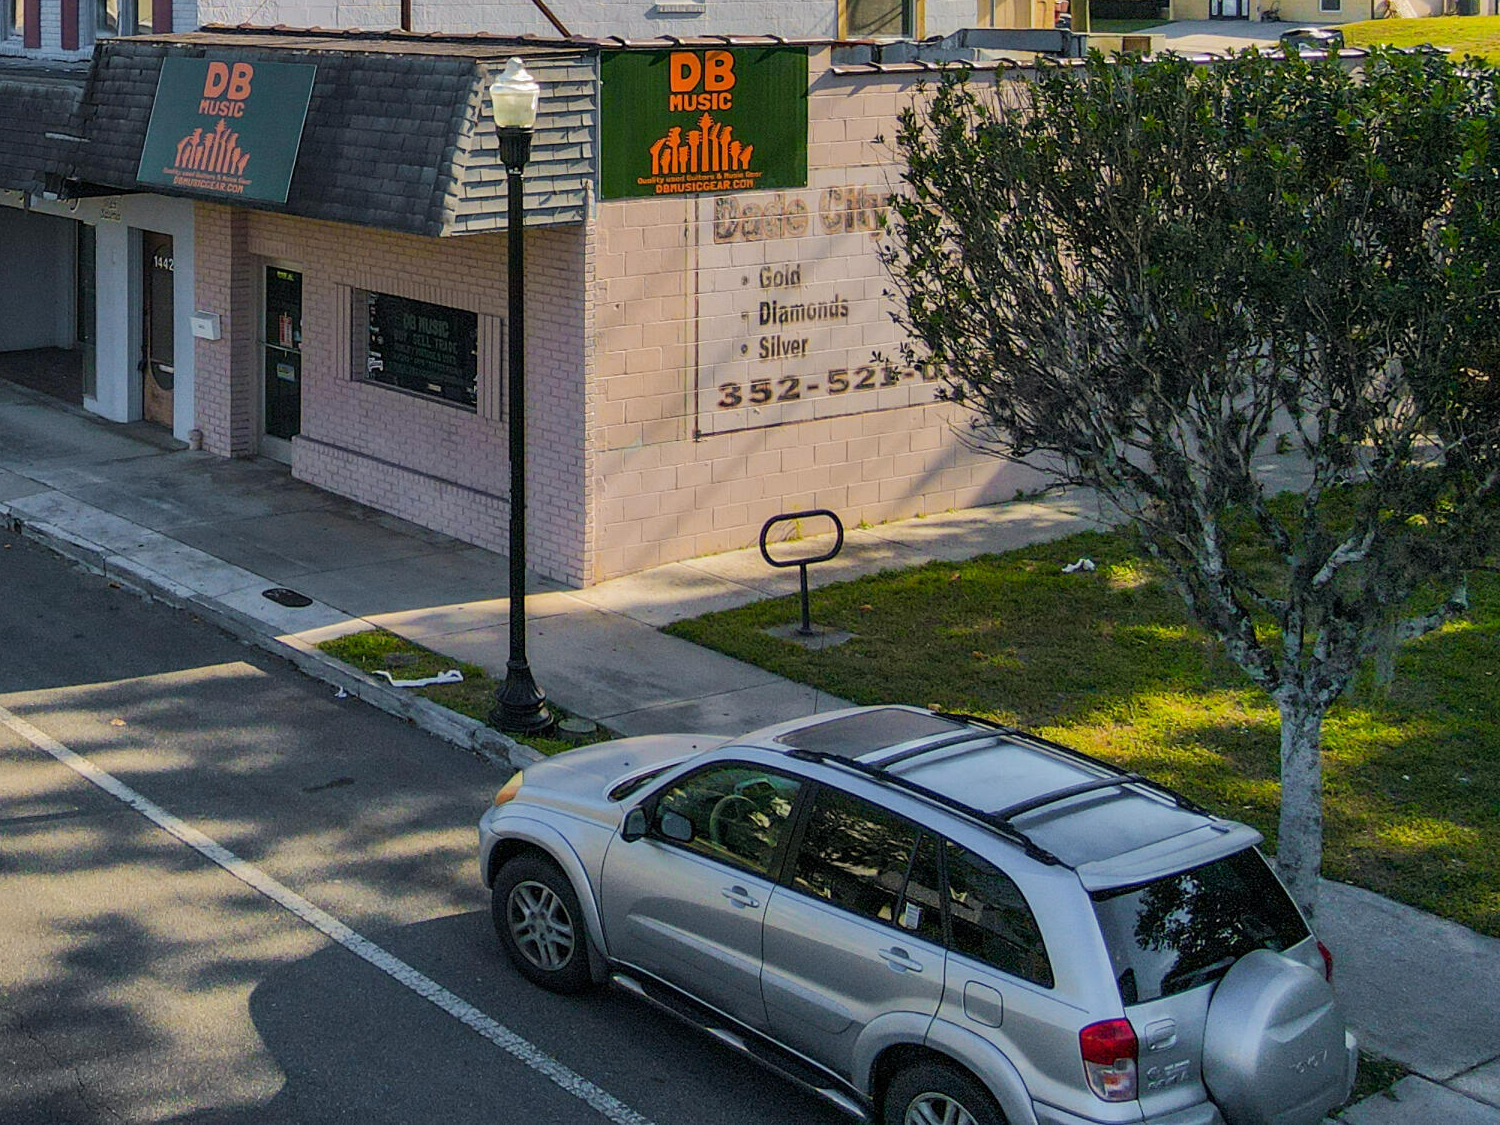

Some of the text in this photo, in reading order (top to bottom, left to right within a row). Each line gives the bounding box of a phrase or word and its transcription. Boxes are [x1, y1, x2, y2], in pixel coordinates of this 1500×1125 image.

[203, 61, 254, 100] DB
[670, 50, 736, 92] DB
[198, 99, 245, 118] MUSIC
[669, 92, 732, 112] MUSIC
[173, 176, 244, 194] DBMUSICGEAR.COM
[637, 176, 665, 185] Quality
[686, 173, 715, 182] Guitars
[723, 171, 744, 179] Music
[745, 170, 763, 178] Gear
[655, 178, 754, 194] DBMUSICGEAR.COM
[714, 183, 892, 244] Dade City
[153, 255, 175, 272] 1442
[759, 263, 801, 290] Gold
[758, 293, 850, 326] Diamonds
[403, 312, 449, 339] DB MUSIC
[758, 334, 809, 360] Silver
